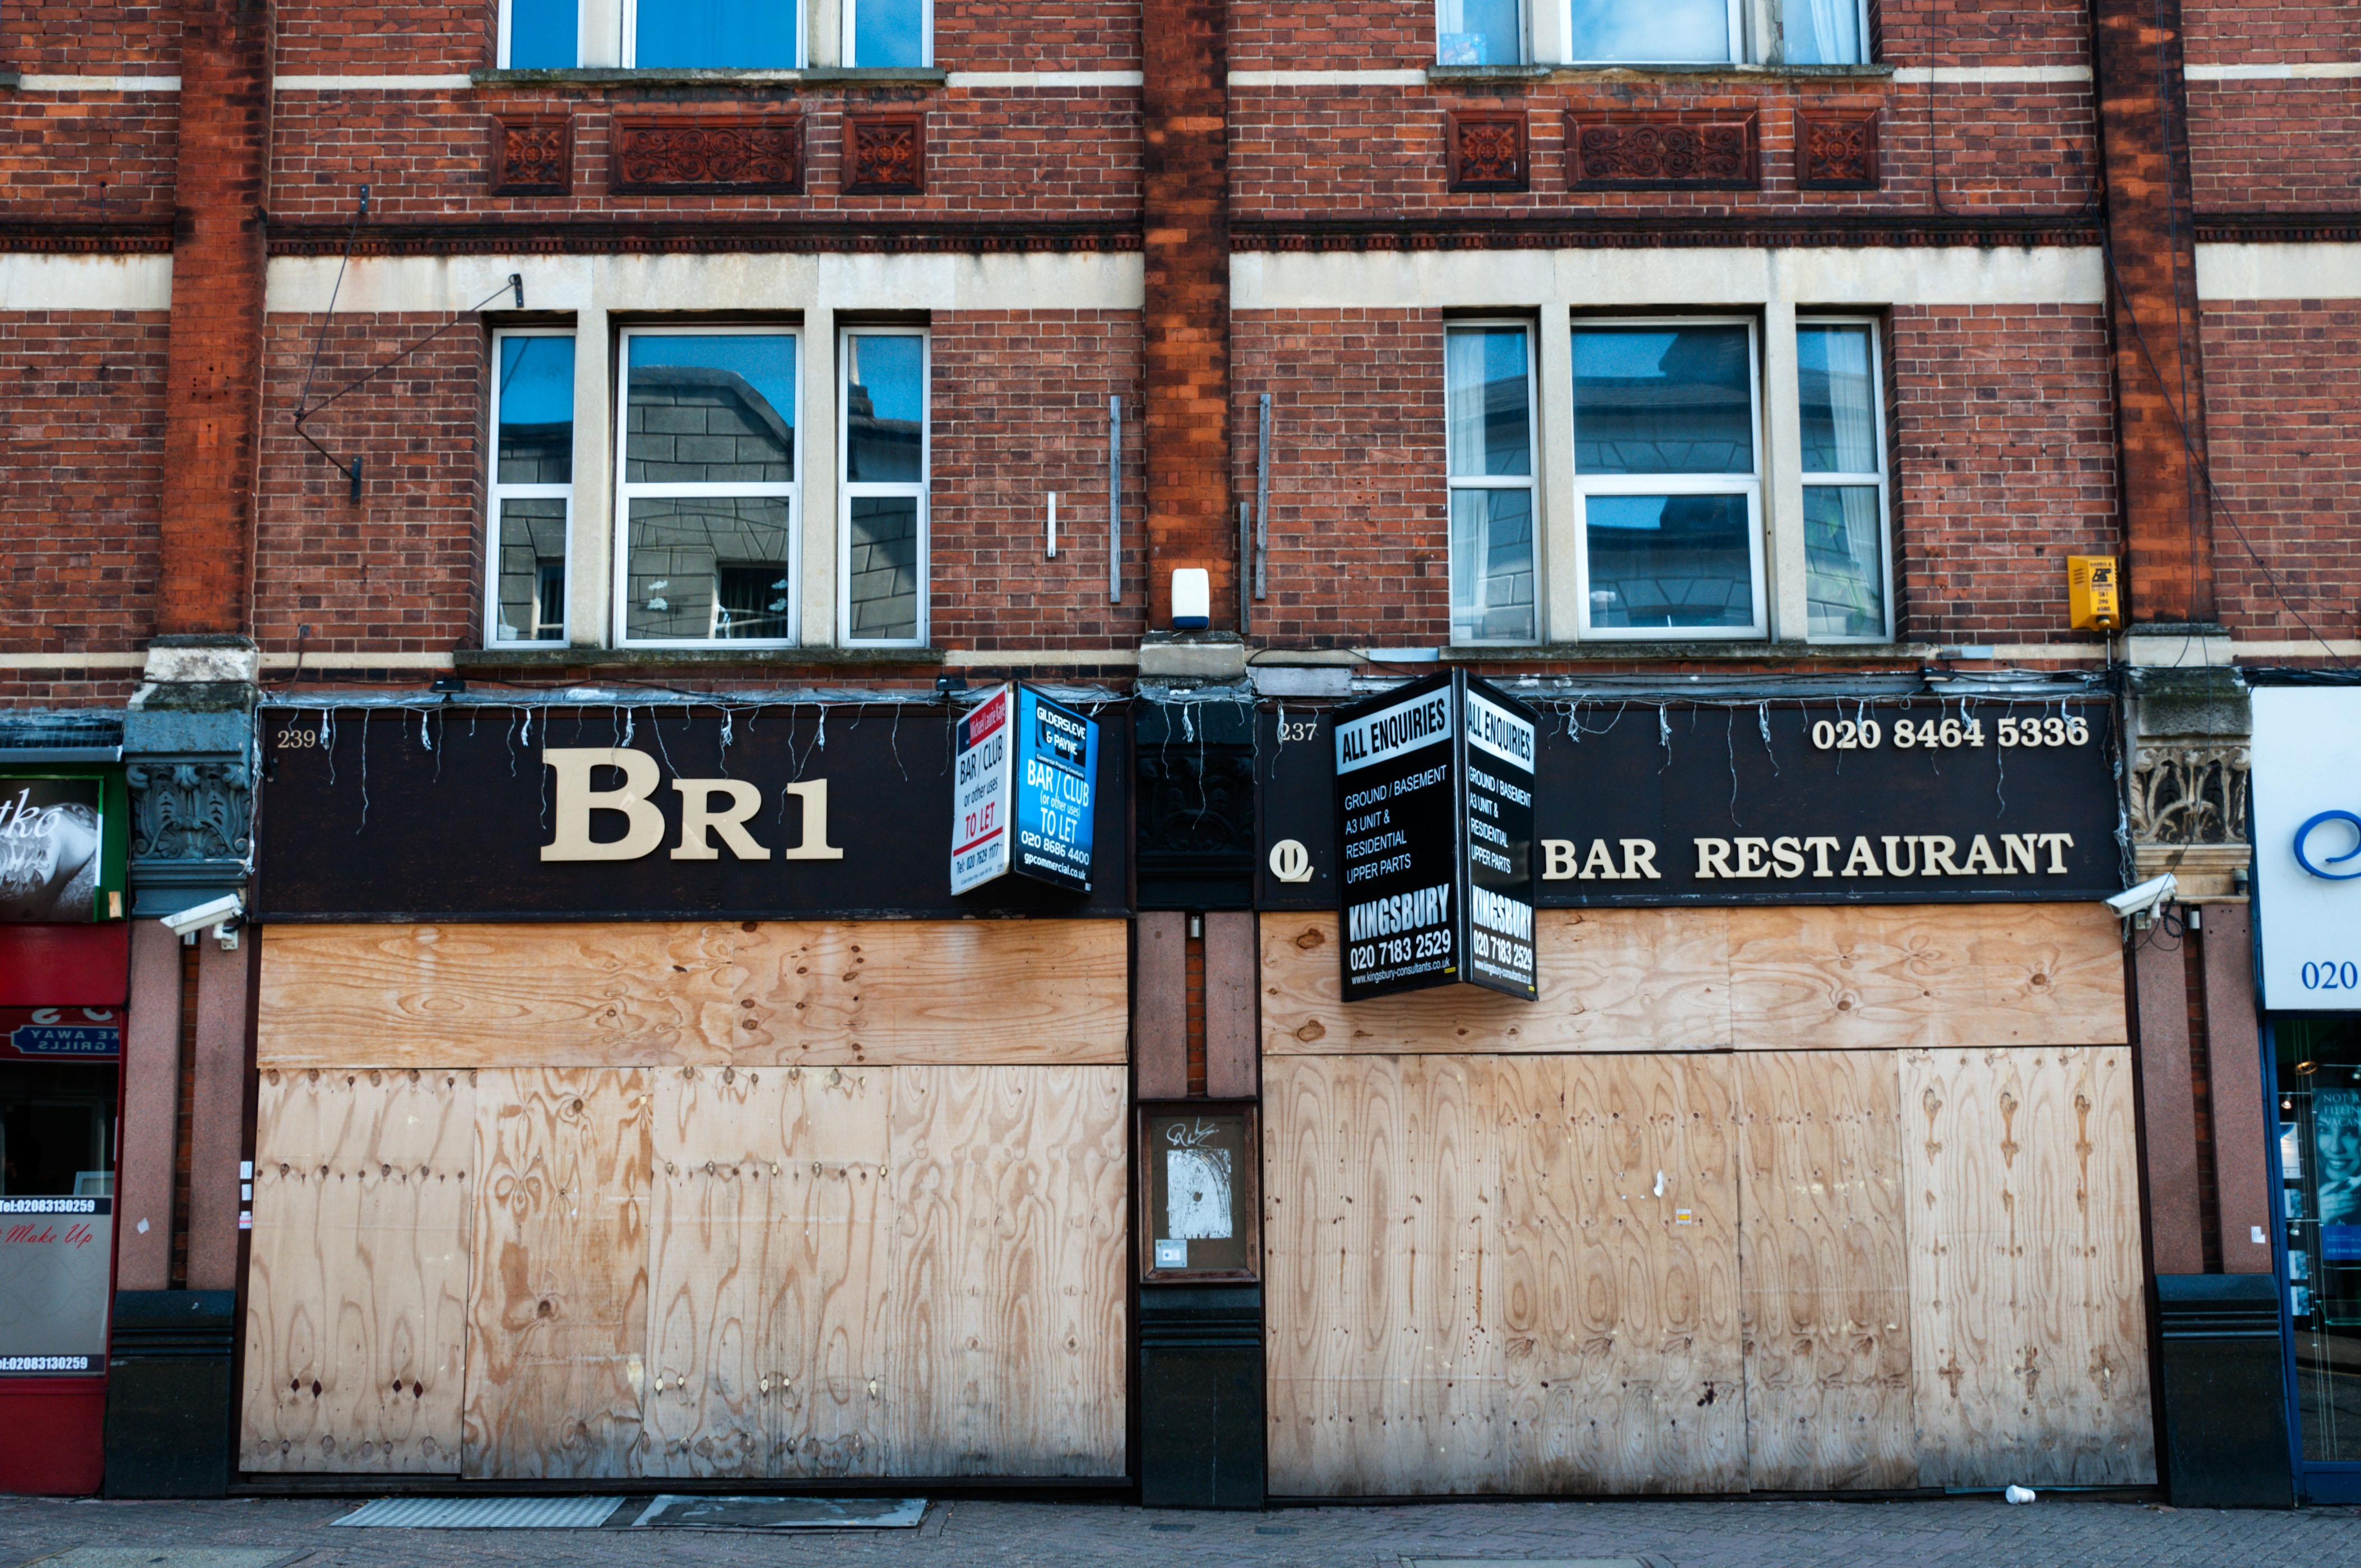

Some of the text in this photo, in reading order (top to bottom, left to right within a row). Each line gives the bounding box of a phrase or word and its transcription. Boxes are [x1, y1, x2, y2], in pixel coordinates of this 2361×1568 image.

[277, 730, 316, 749] 239
[1037, 707, 1086, 740] GILDERSLEVE
[1343, 698, 1445, 764] ALL ENQUIRIES
[1468, 701, 1530, 762] ALL ENQUIRIES
[1812, 716, 2089, 749] 020 8464 5336
[1046, 730, 1078, 755] & PAYNE
[960, 735, 1003, 786] BAR / CLUB
[964, 777, 998, 808] or other uses
[1027, 759, 1089, 807] BAR / CLUB
[1344, 764, 1447, 810] GROUND / BASEMENT
[1469, 766, 1532, 808] GROUND / BASEMENT
[541, 748, 843, 861] BR1
[966, 801, 995, 839] TO LET
[1040, 789, 1080, 820] (or other uses)
[1469, 791, 1499, 818] A3 UNIT &
[1041, 807, 1078, 844] TO LET
[1346, 809, 1390, 836] A3 UNIT &
[1471, 817, 1509, 848] RESIDENTIAL
[1021, 831, 1089, 865] 020 8686 4400
[1346, 829, 1407, 860] RESIDENTIAL
[1471, 843, 1511, 874] UPPER PARTS
[1541, 838, 1661, 880] BAR
[1694, 833, 2074, 879] RESTAURANT
[967, 854, 975, 870] 020
[1024, 853, 1086, 880] gpcommercial.co.uk
[1347, 853, 1412, 884] UPPER PARTS
[1349, 883, 1450, 942] KINGSBURY
[1472, 884, 1532, 941] KINGSBURY
[1350, 929, 1451, 971] 020 7183 2529
[1473, 929, 1533, 971] 020 7183 2529
[1351, 956, 1450, 985] www.kingsbury-consultants.co.uk
[1474, 959, 1532, 991] www.kingsbury-consultants.co.uk
[2302, 961, 2358, 990] 020
[2323, 1093, 2346, 1103] NOT
[4, 1223, 93, 1249] Make Up
